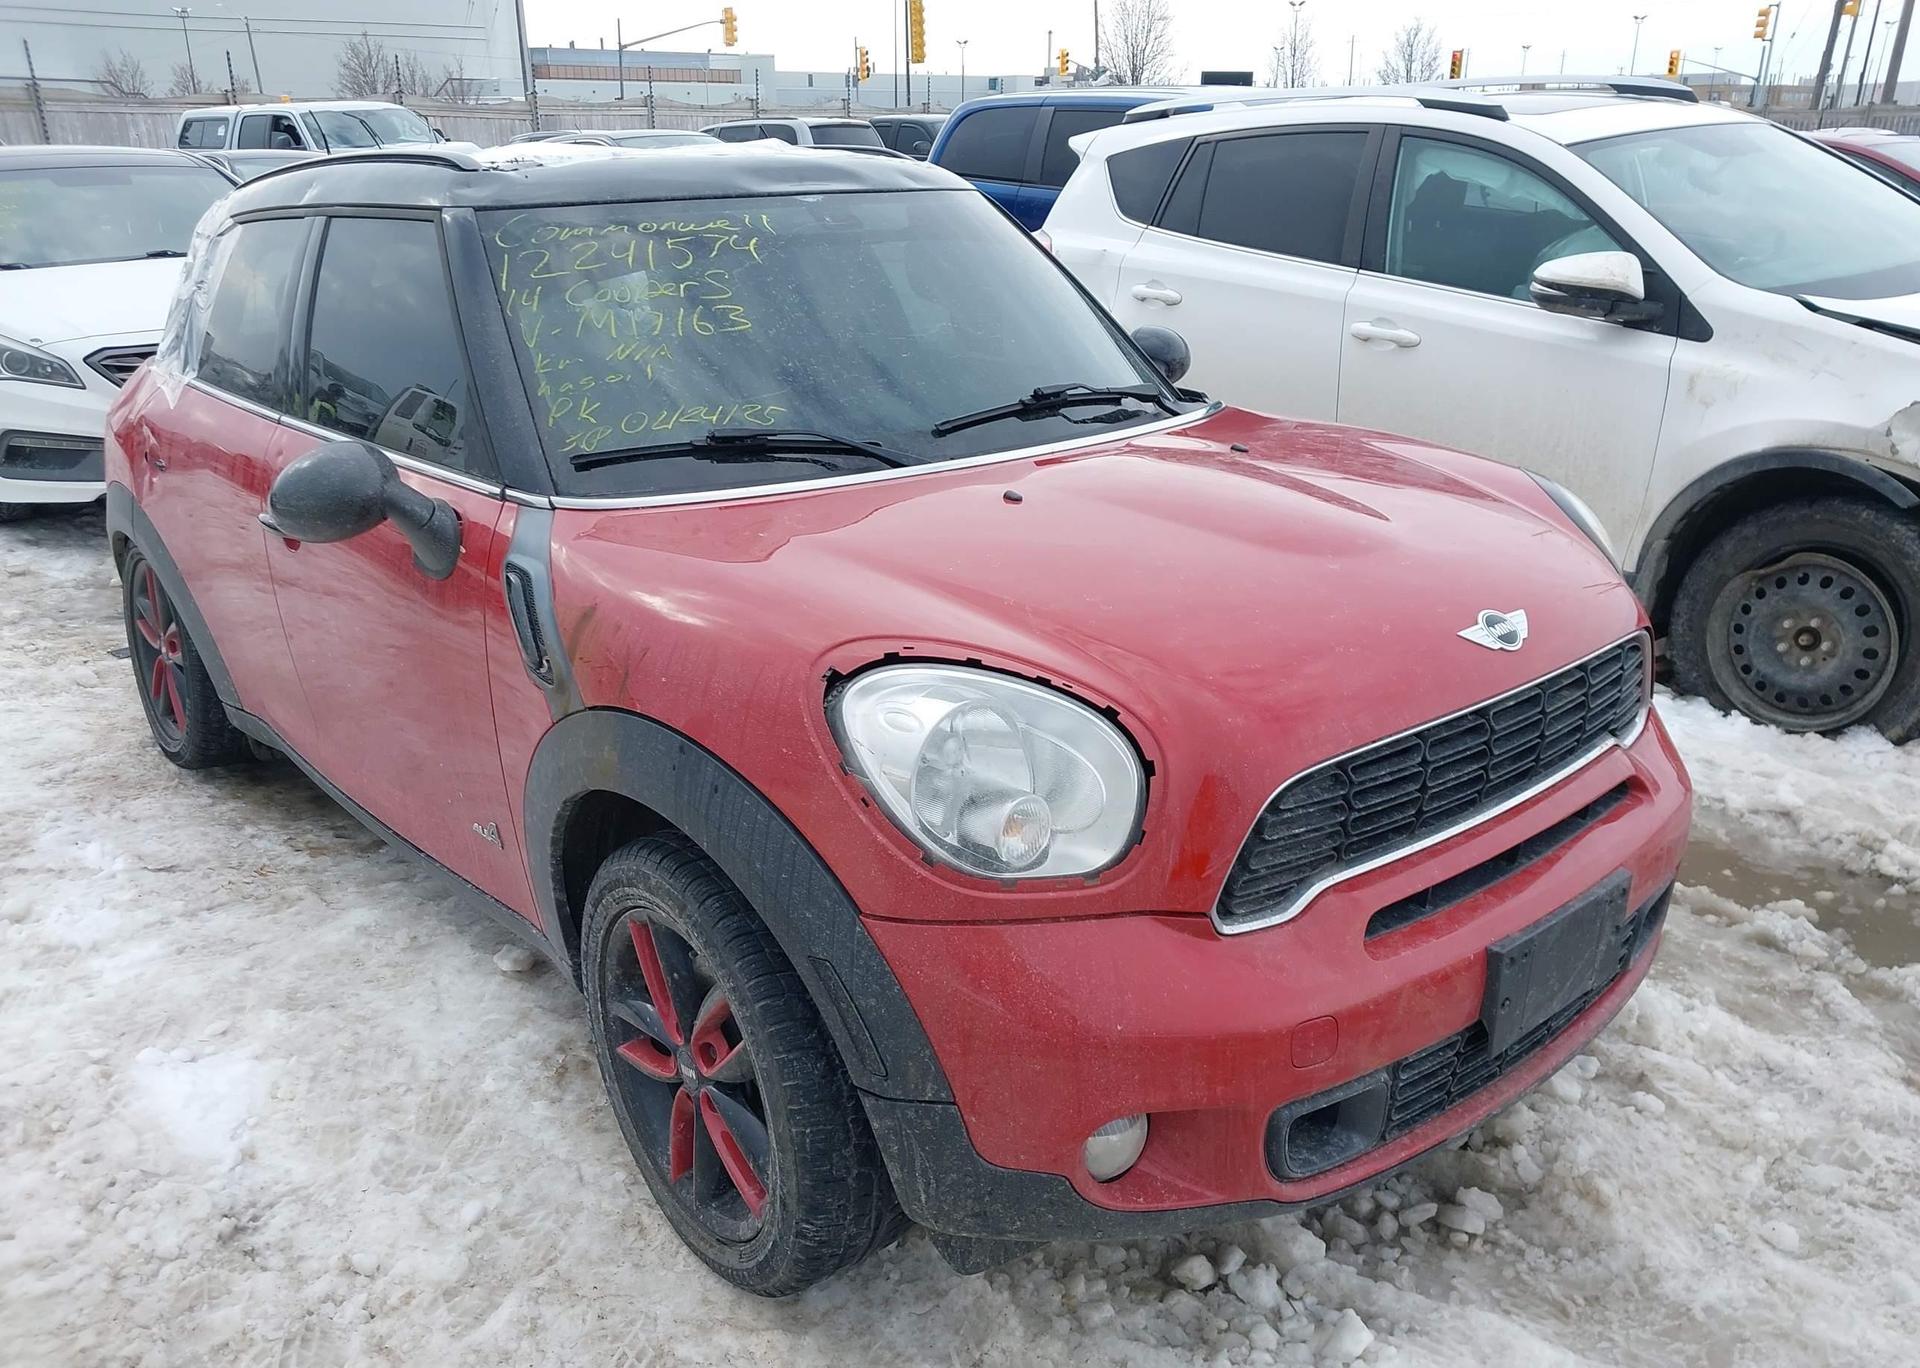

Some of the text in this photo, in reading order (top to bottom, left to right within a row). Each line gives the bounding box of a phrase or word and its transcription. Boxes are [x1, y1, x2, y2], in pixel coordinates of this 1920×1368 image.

[500, 233, 764, 291] 12241574
[506, 286, 542, 316] 14
[606, 341, 673, 361] N/A
[1488, 620, 1517, 638] MINI
